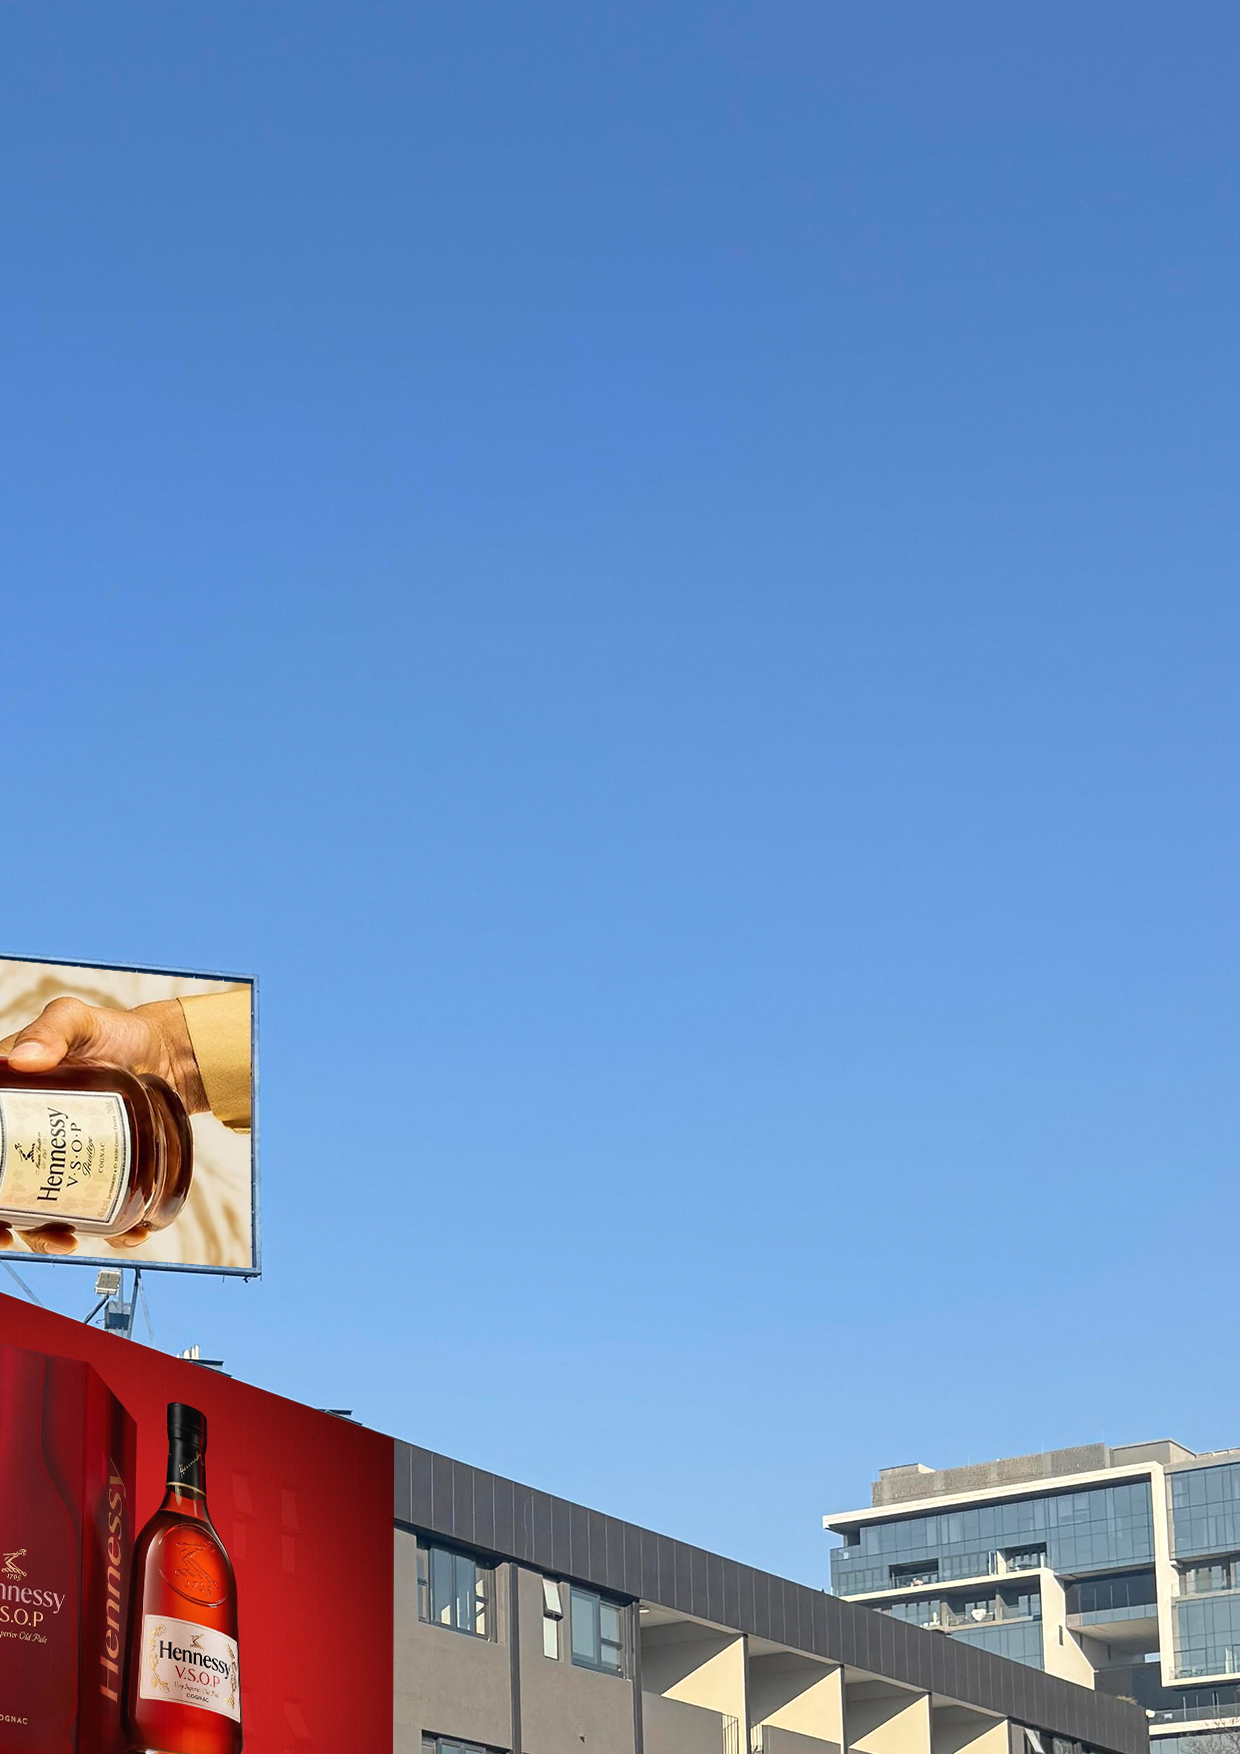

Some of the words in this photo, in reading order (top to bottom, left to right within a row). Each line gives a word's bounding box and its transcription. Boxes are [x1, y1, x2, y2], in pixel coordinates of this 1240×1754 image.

[36, 1106, 69, 1202] Hennessy
[98, 1456, 127, 1703] Hennessy
[159, 1640, 231, 1680] Hennessy
[175, 1665, 221, 1688] V.S.O.P
